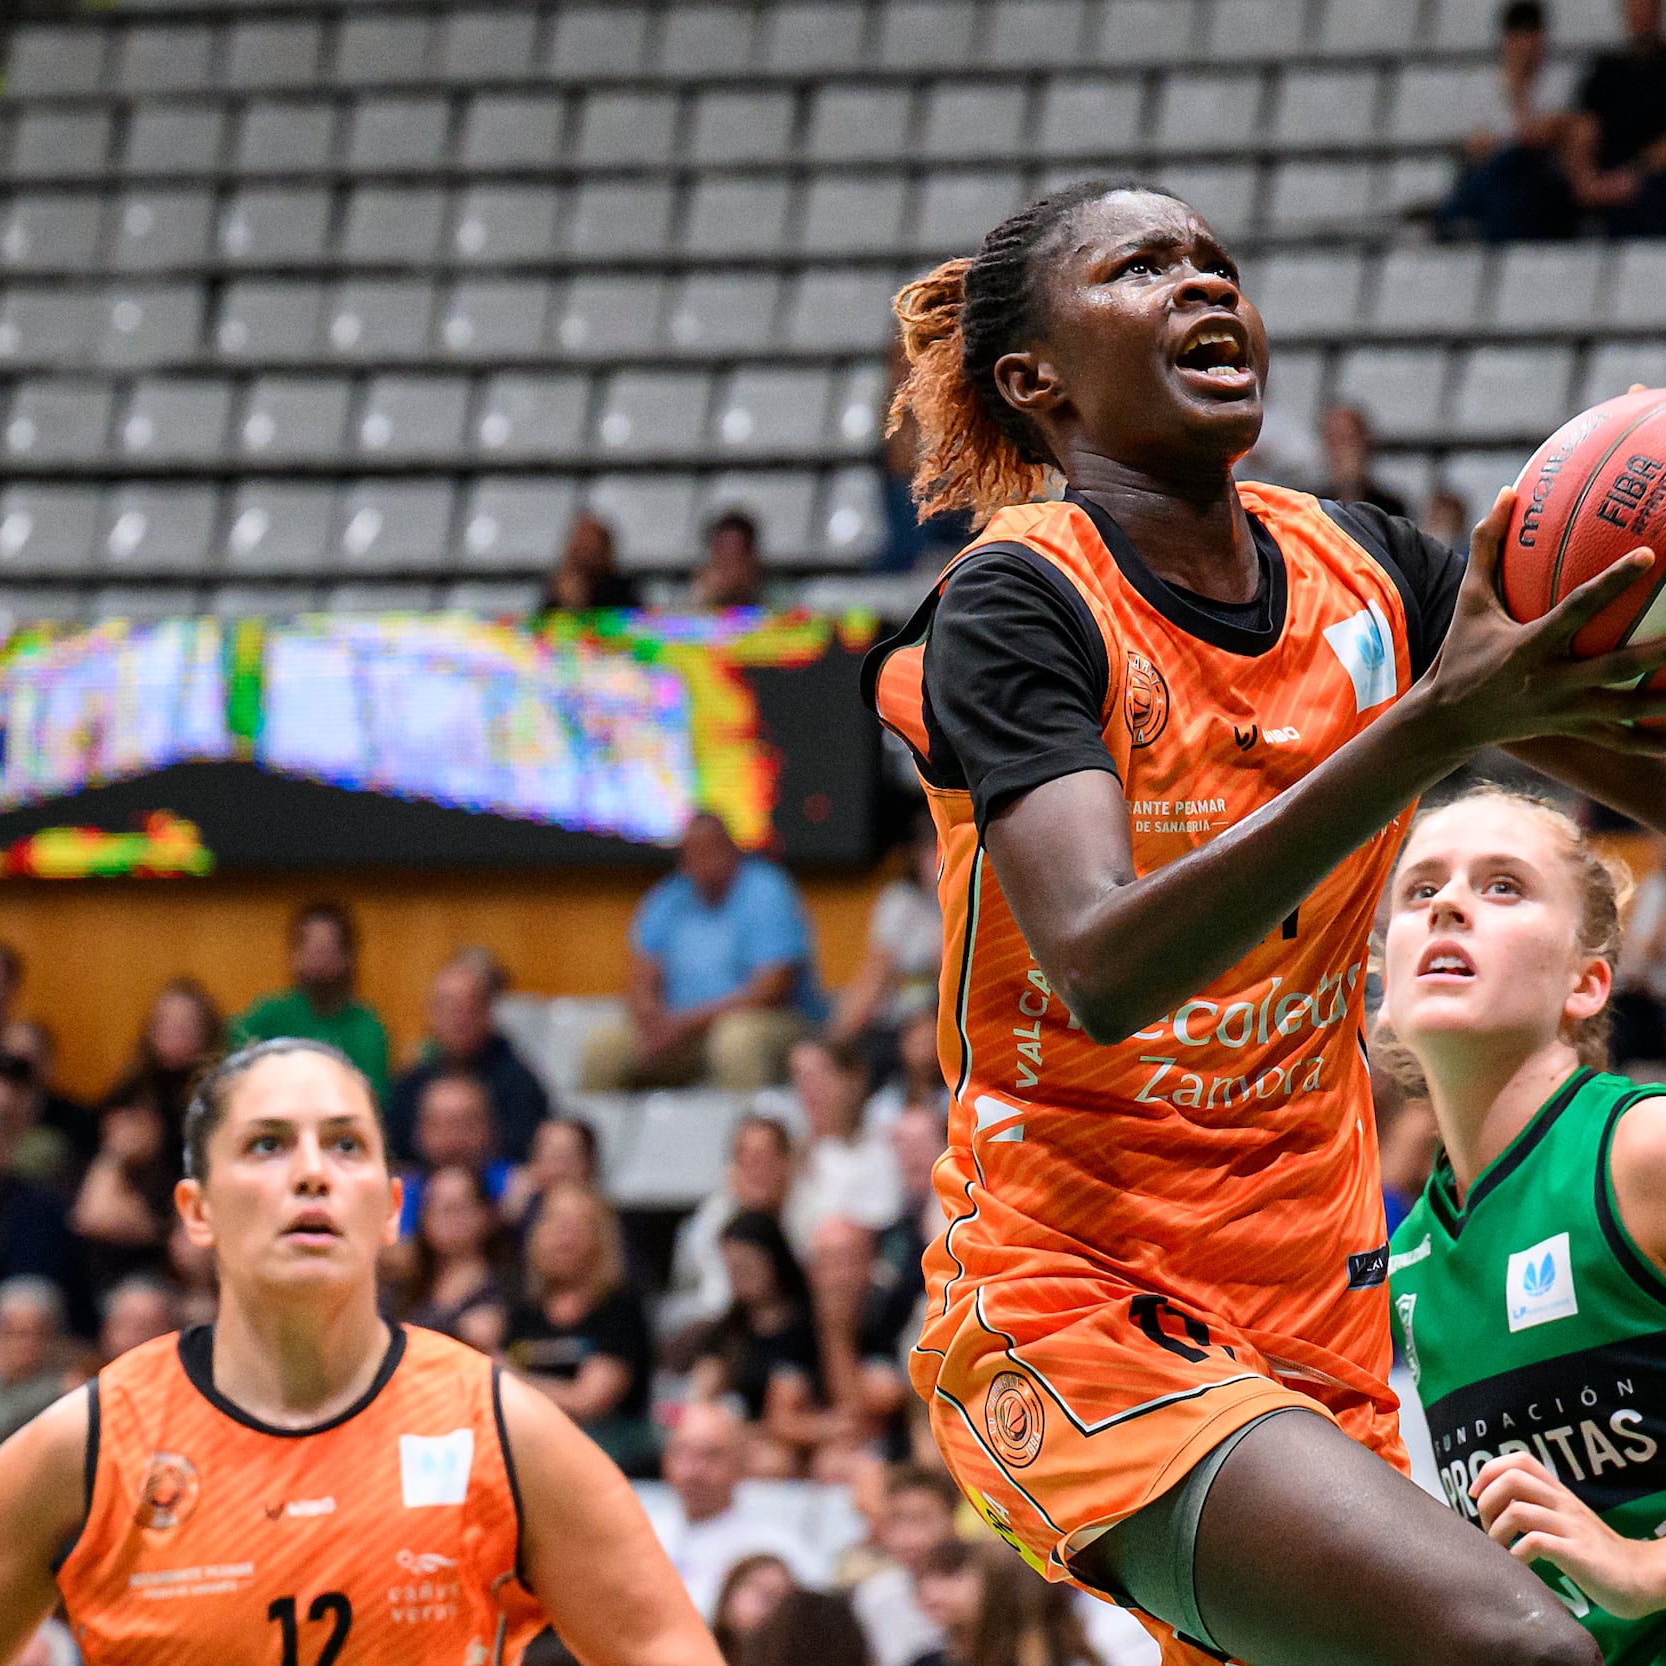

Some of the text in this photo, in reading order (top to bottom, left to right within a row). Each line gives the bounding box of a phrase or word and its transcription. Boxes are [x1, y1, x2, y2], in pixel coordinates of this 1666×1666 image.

[1597, 453, 1663, 530] FIBA
[1136, 819, 1210, 833] DE SANABRIA
[1175, 797, 1226, 816] PEAMAR
[1135, 1055, 1324, 1110] Zamora
[1440, 1408, 1658, 1522] PROITAS
